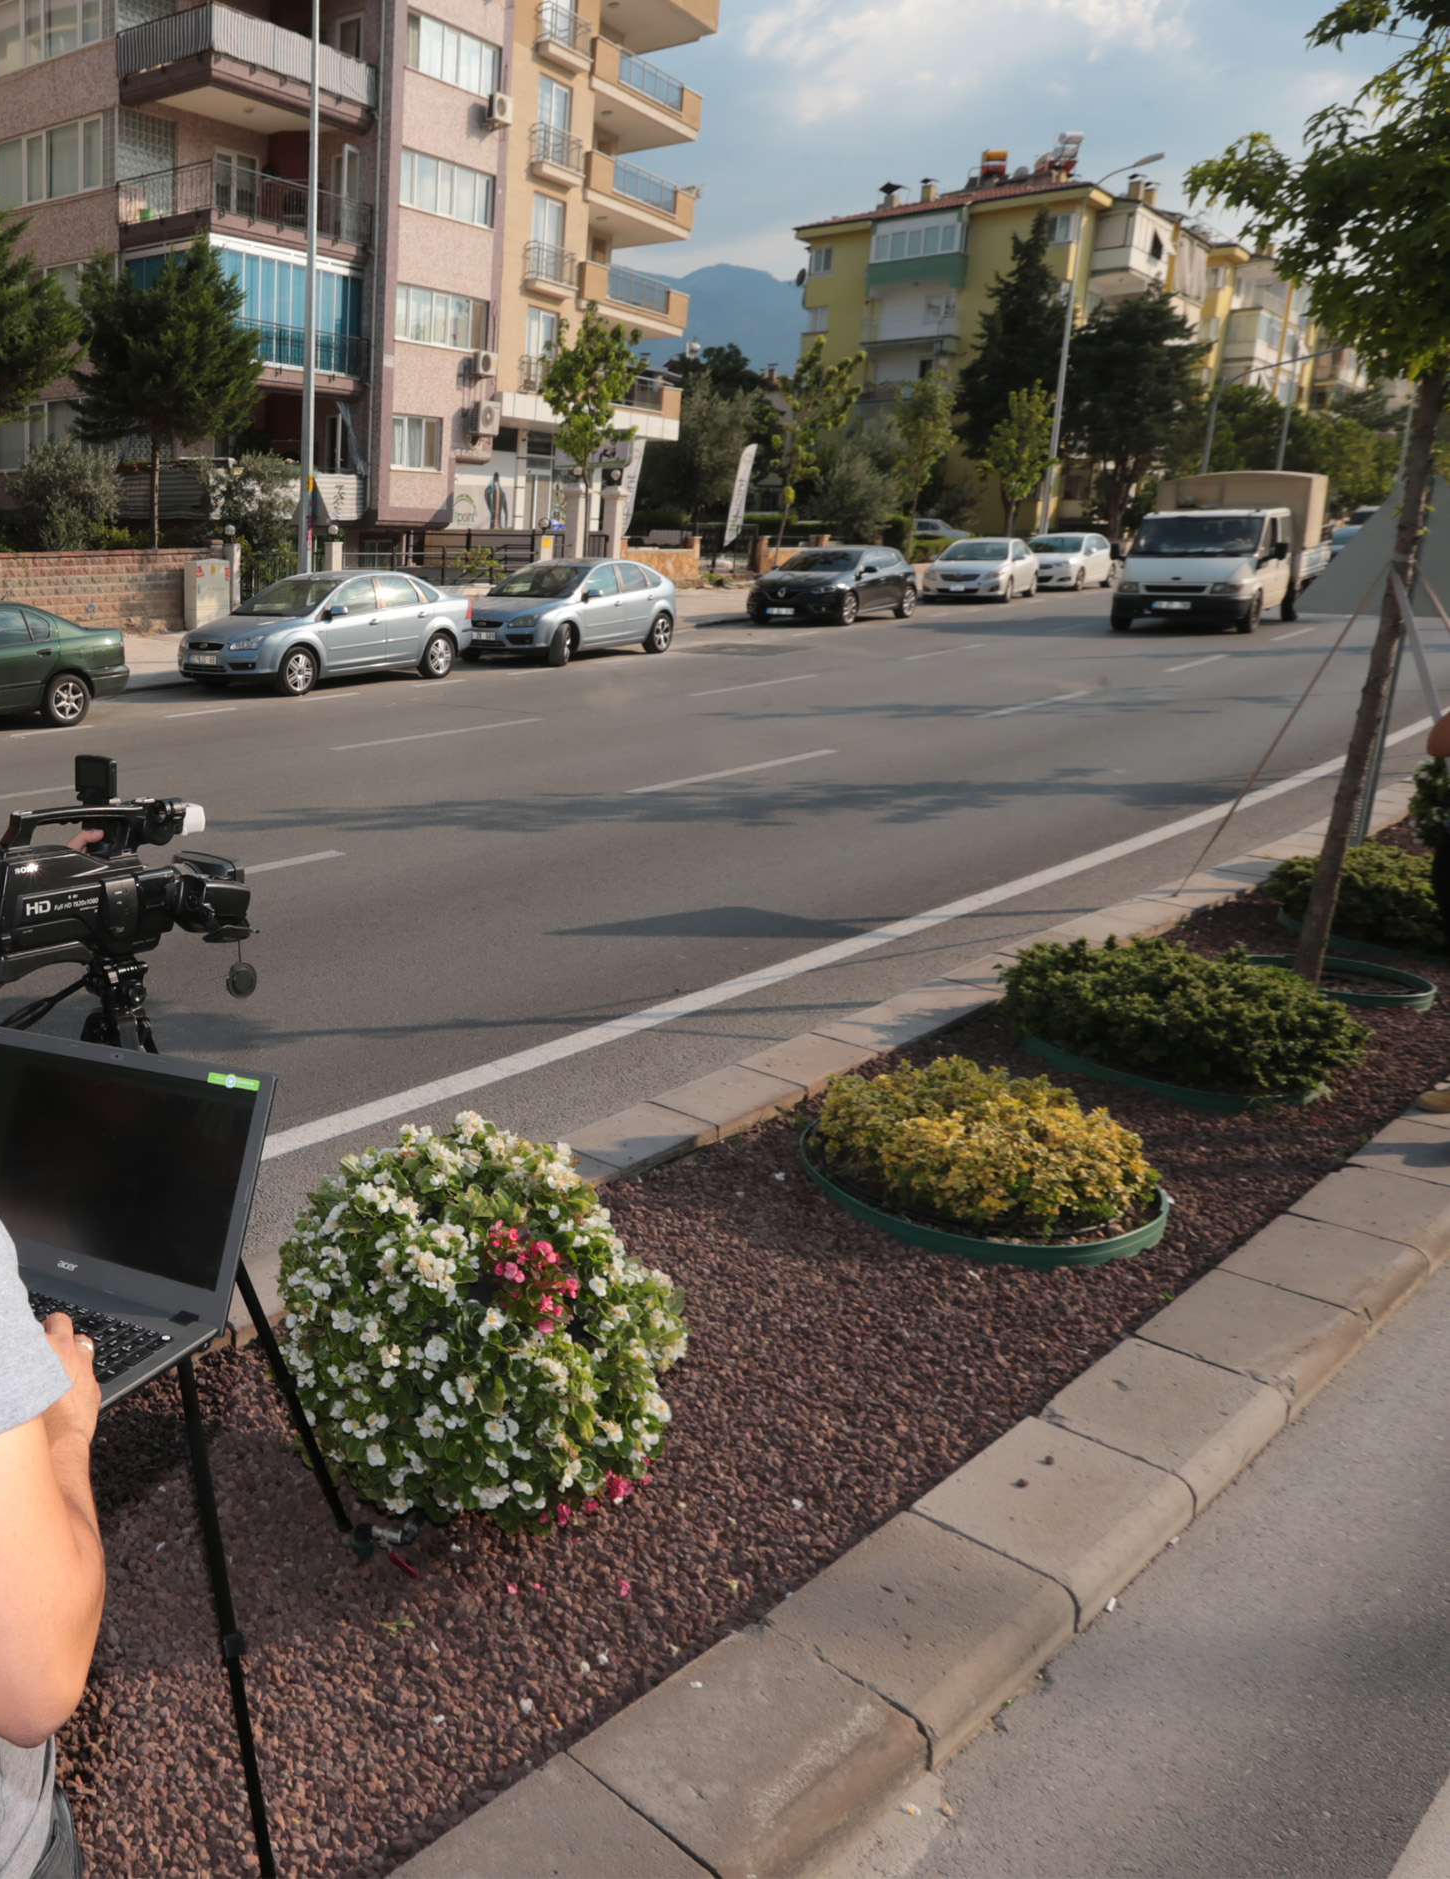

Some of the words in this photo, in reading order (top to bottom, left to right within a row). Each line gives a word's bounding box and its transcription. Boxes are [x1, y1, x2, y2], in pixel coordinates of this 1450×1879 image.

[26, 900, 51, 916] HD
[54, 903, 64, 911] Full
[57, 1260, 78, 1271] acer
